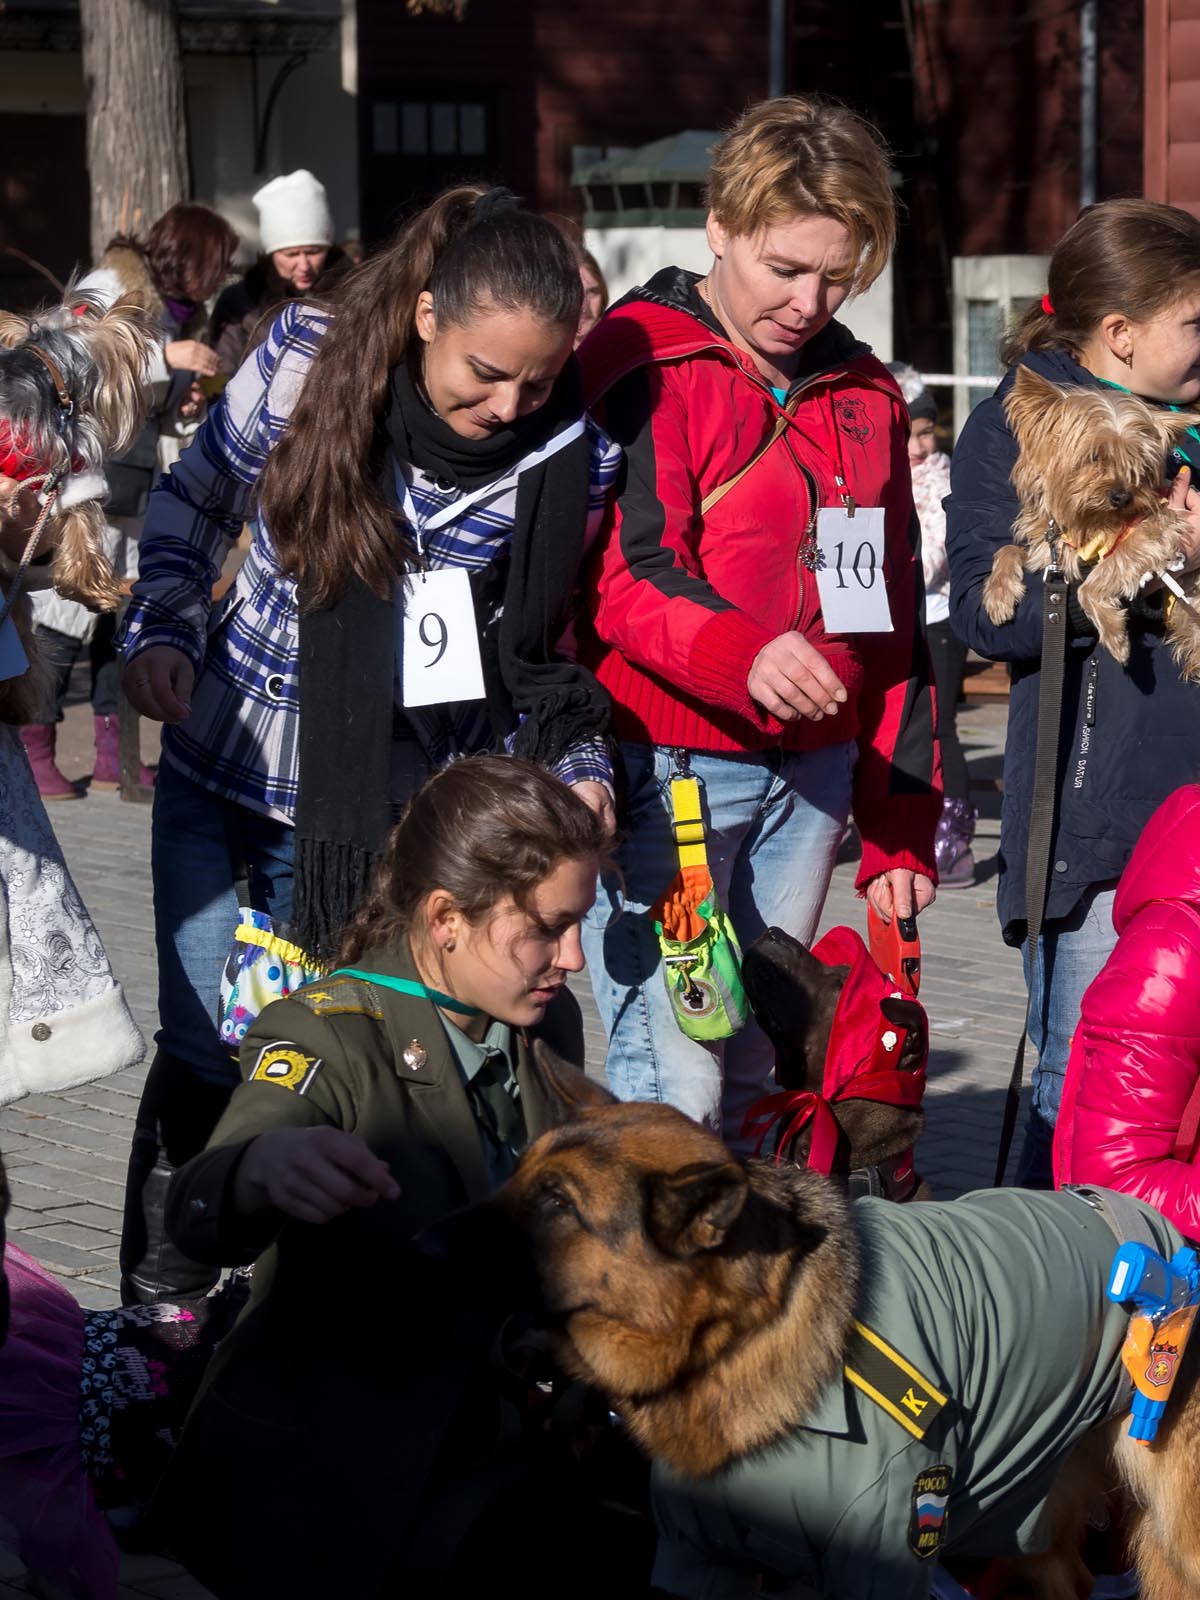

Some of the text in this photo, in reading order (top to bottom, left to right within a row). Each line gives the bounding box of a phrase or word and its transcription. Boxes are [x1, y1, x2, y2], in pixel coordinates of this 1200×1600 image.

[834, 541, 877, 589] 10
[418, 612, 448, 668] 9
[901, 1387, 928, 1417] К
